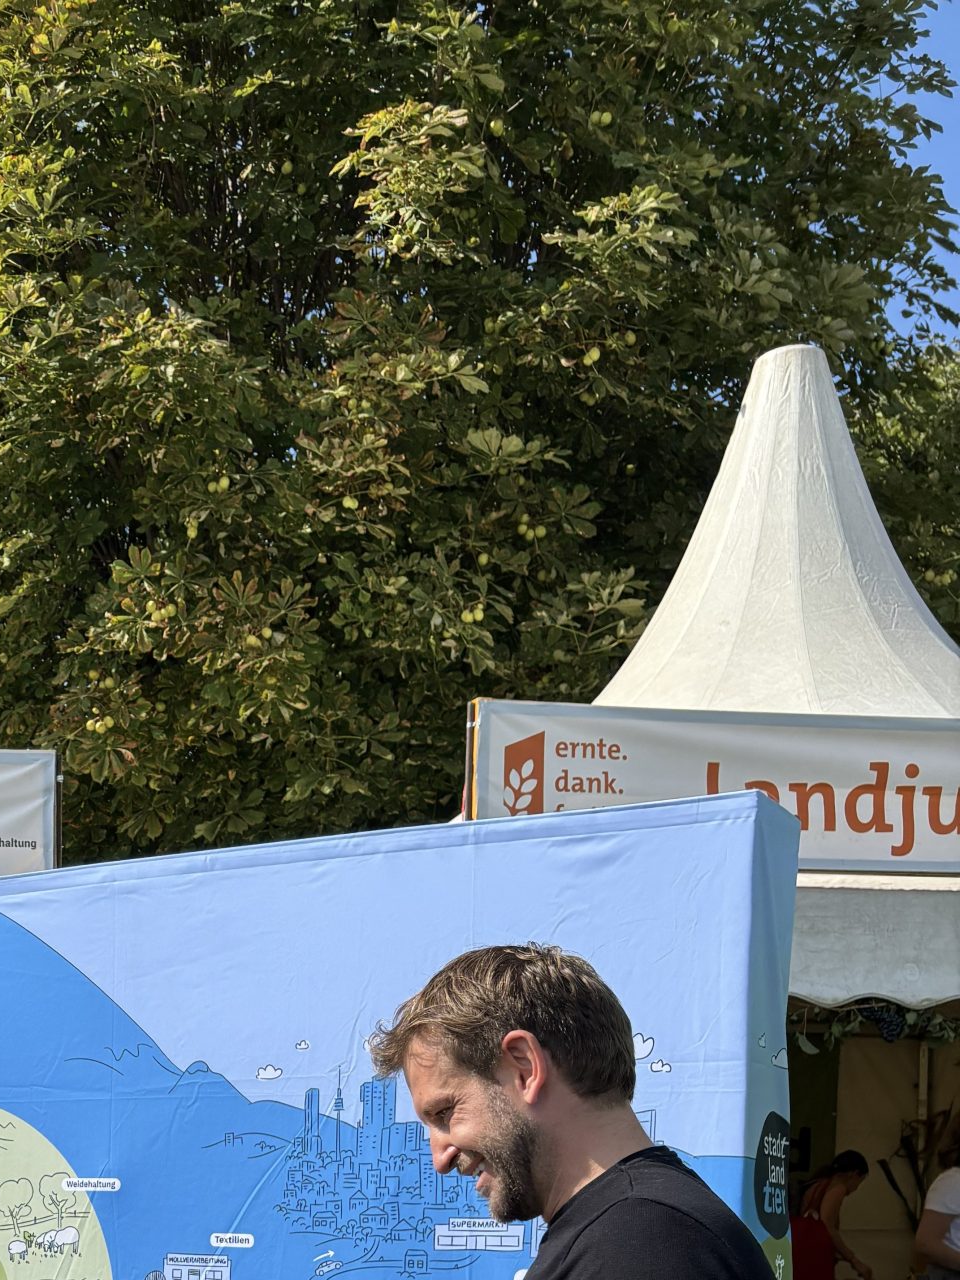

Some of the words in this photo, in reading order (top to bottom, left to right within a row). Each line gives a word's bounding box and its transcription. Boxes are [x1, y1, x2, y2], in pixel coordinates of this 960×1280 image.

[555, 737, 628, 761] ernte.
[554, 769, 625, 795] dank.
[763, 1132, 790, 1159] stadt
[768, 1158, 785, 1185] land
[66, 1180, 116, 1190] Weidehaltung
[763, 1180, 787, 1214] tier
[214, 1235, 250, 1246] Textilien
[168, 1256, 227, 1266] WOLLVERARBEITUNG
